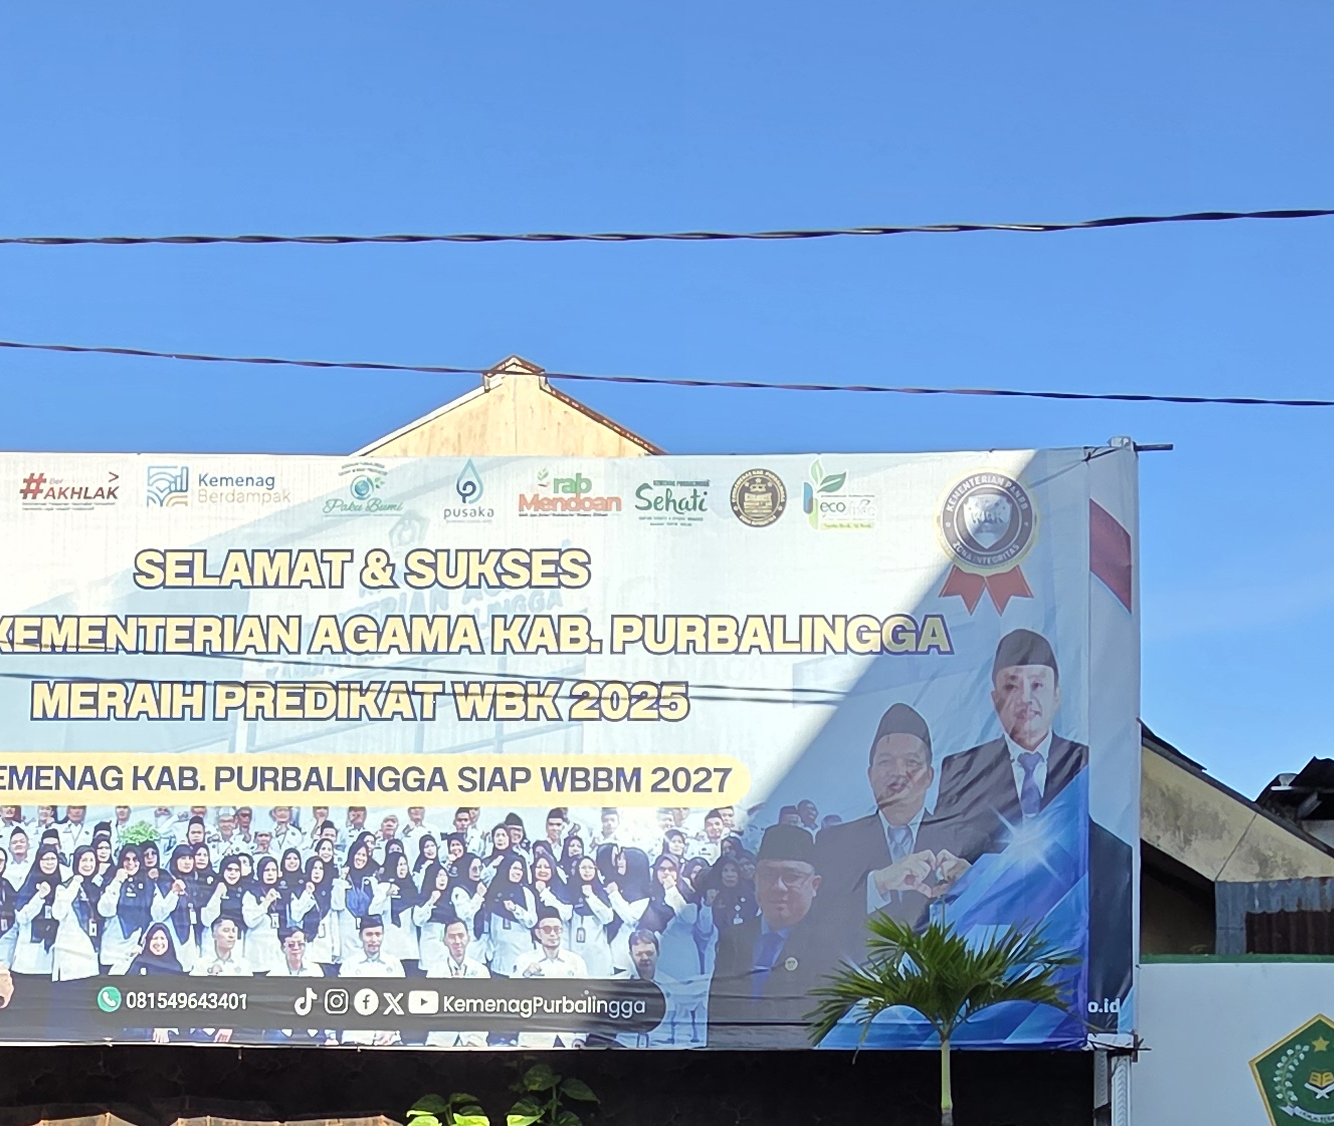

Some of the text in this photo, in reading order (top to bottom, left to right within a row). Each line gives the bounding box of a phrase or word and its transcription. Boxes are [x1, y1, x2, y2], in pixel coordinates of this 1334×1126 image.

[198, 473, 275, 490] Kemenag
[553, 472, 593, 494] rab
[198, 489, 292, 504] Berdampak
[518, 492, 622, 512] Mendoan
[634, 482, 708, 515] Sehati
[443, 506, 495, 520] pusaka
[134, 548, 592, 589] SELAMAT & SUKSES
[308, 614, 484, 656] AGAMA
[490, 614, 603, 655] KAB.
[612, 614, 955, 656] PURBALINGGA
[30, 680, 691, 722] MERAIH PREDIKAT WBK 2025
[132, 765, 206, 792] KAB.
[214, 765, 449, 793] PURBALINGGA
[457, 766, 532, 793] SIAP
[540, 767, 641, 793] WBBM
[650, 767, 733, 793] 2027
[125, 991, 248, 1011] 081549643401
[443, 994, 647, 1018] KemenagPurbalingga
